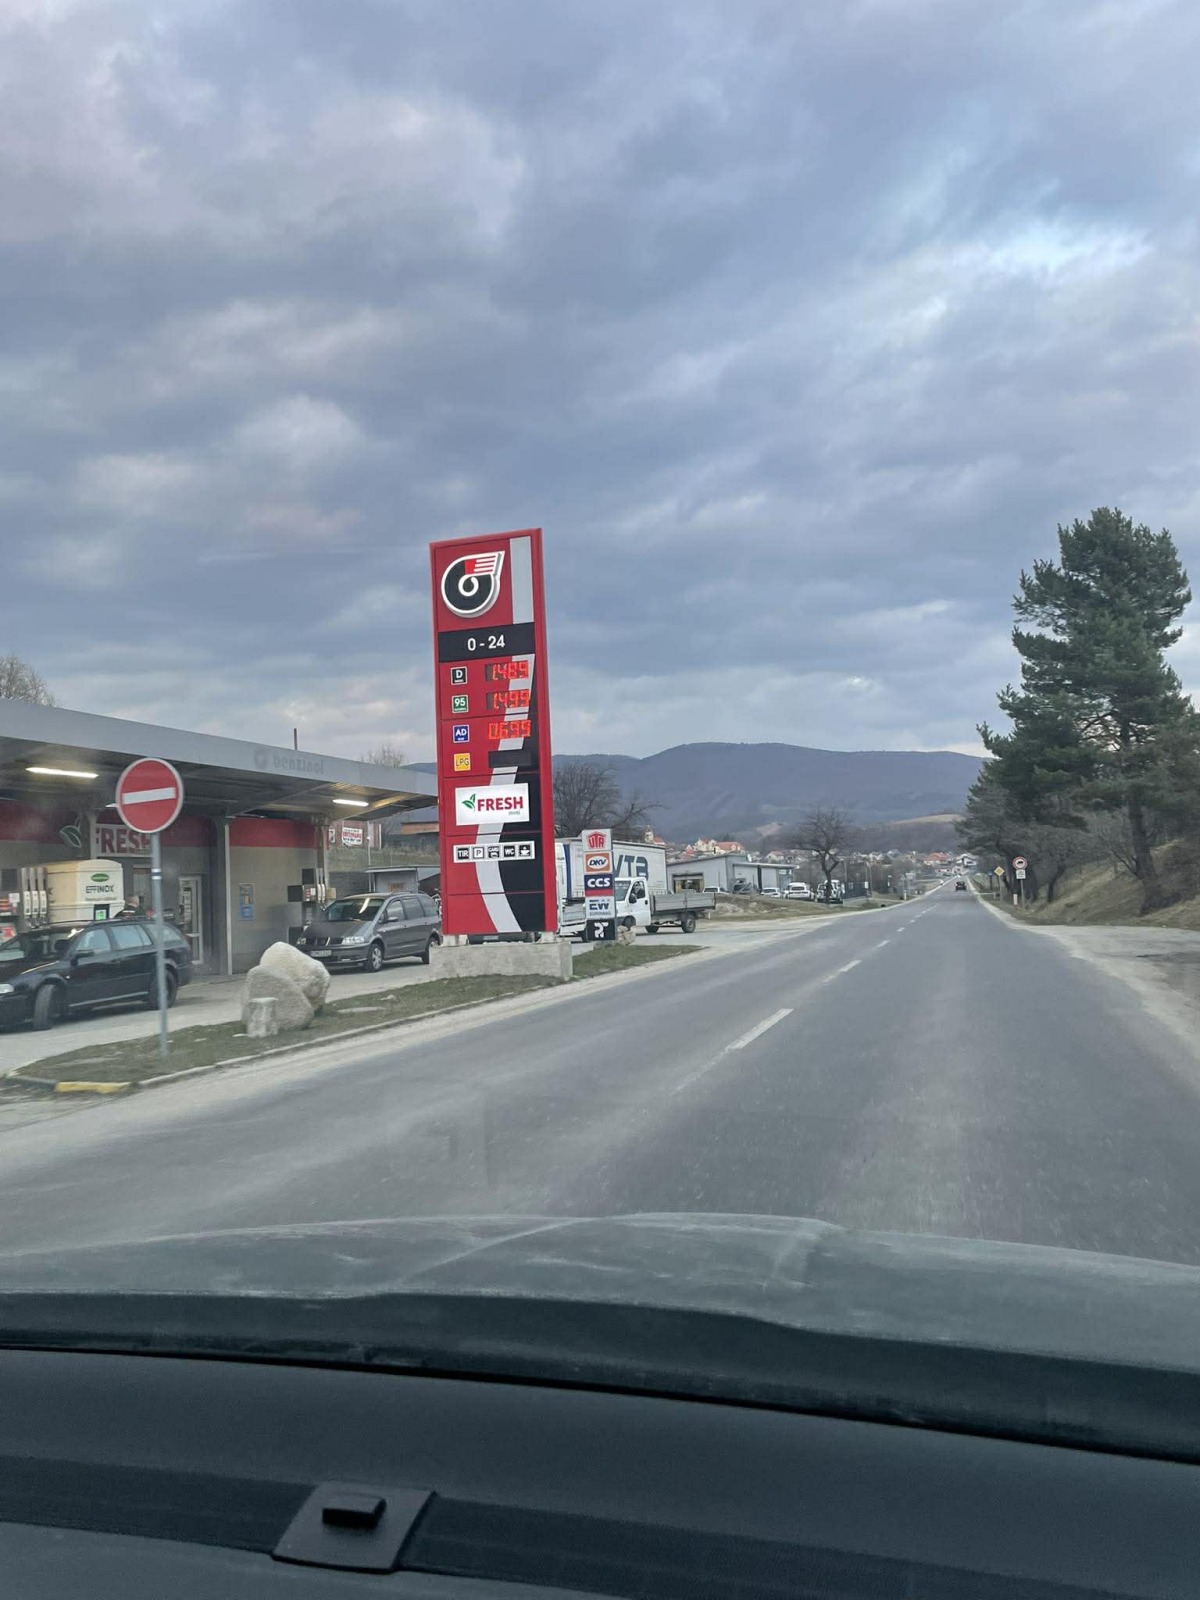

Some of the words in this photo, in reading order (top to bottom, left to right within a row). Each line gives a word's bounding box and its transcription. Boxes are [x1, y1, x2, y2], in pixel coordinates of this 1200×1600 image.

[467, 637, 476, 651] 0
[488, 634, 505, 649] 24
[455, 670, 463, 679] D
[454, 697, 466, 706] 95
[455, 728, 467, 737] AD
[456, 758, 469, 767] LPG
[477, 796, 524, 811] FRESH
[587, 877, 611, 888] CCS
